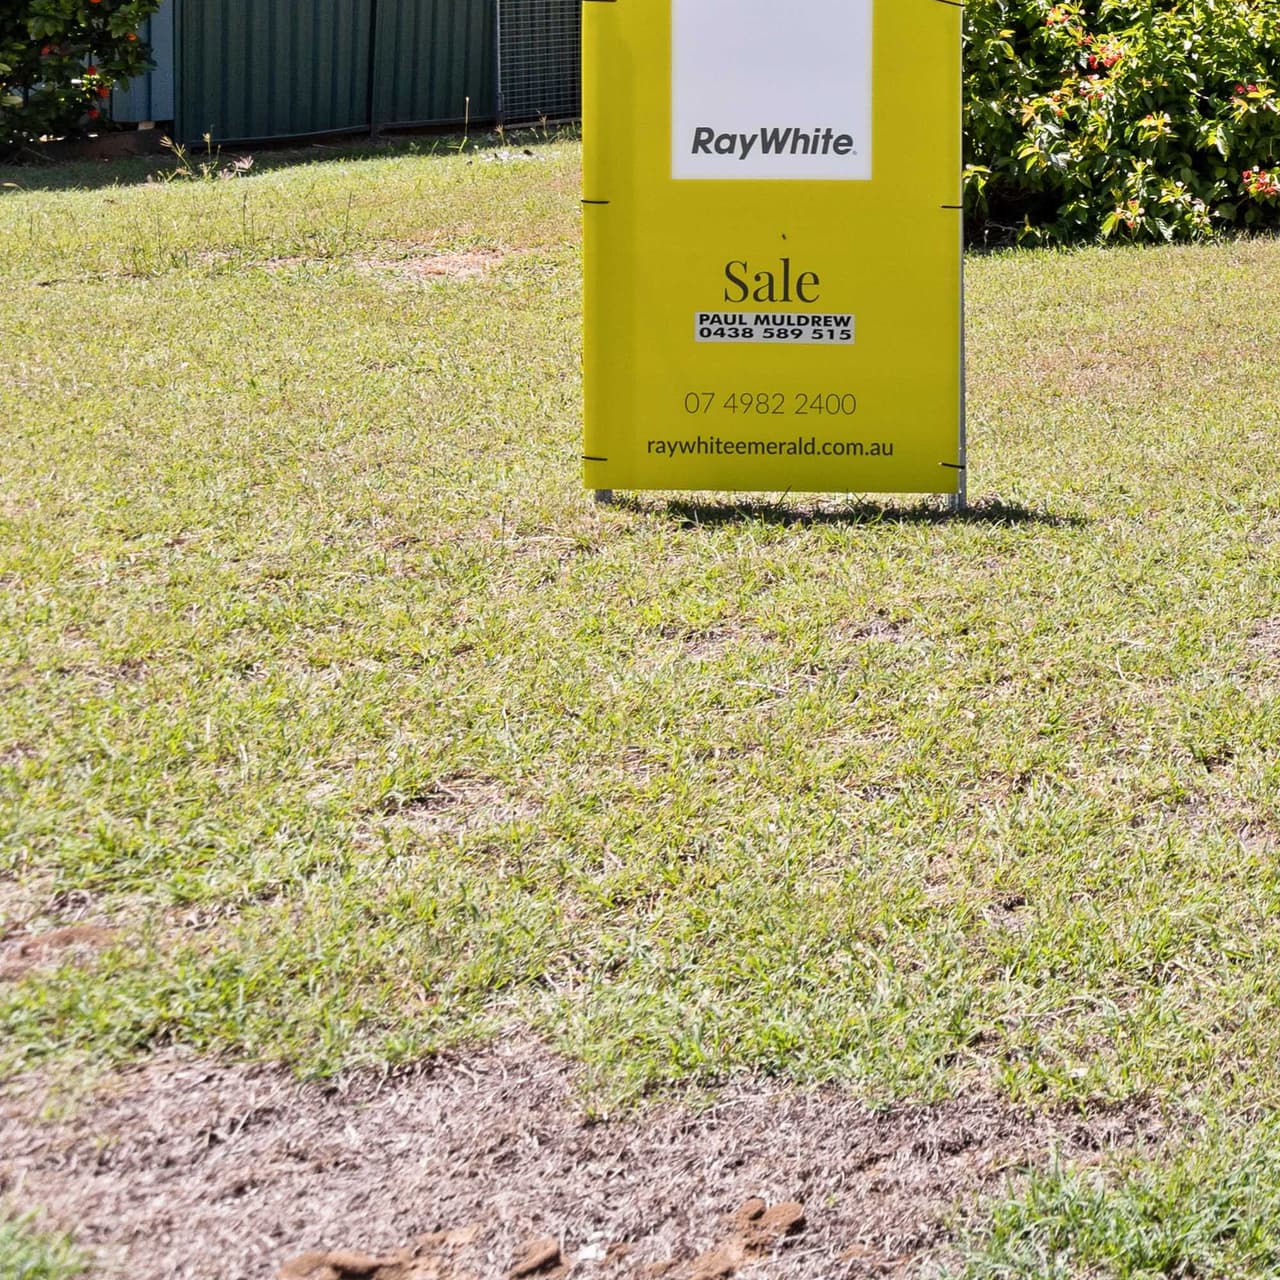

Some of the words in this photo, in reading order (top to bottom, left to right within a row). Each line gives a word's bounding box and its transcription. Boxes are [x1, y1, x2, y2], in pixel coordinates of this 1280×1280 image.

[724, 258, 820, 303] Sale
[699, 314, 748, 326] PAUL
[754, 315, 852, 328] MULDREW
[700, 327, 754, 339] 0438
[763, 328, 804, 339] 589
[811, 329, 852, 341] 515
[684, 392, 715, 414] 07
[723, 393, 785, 415] 4982
[795, 394, 857, 416] 2400
[647, 436, 894, 458] raywhiteemerald.com.au
